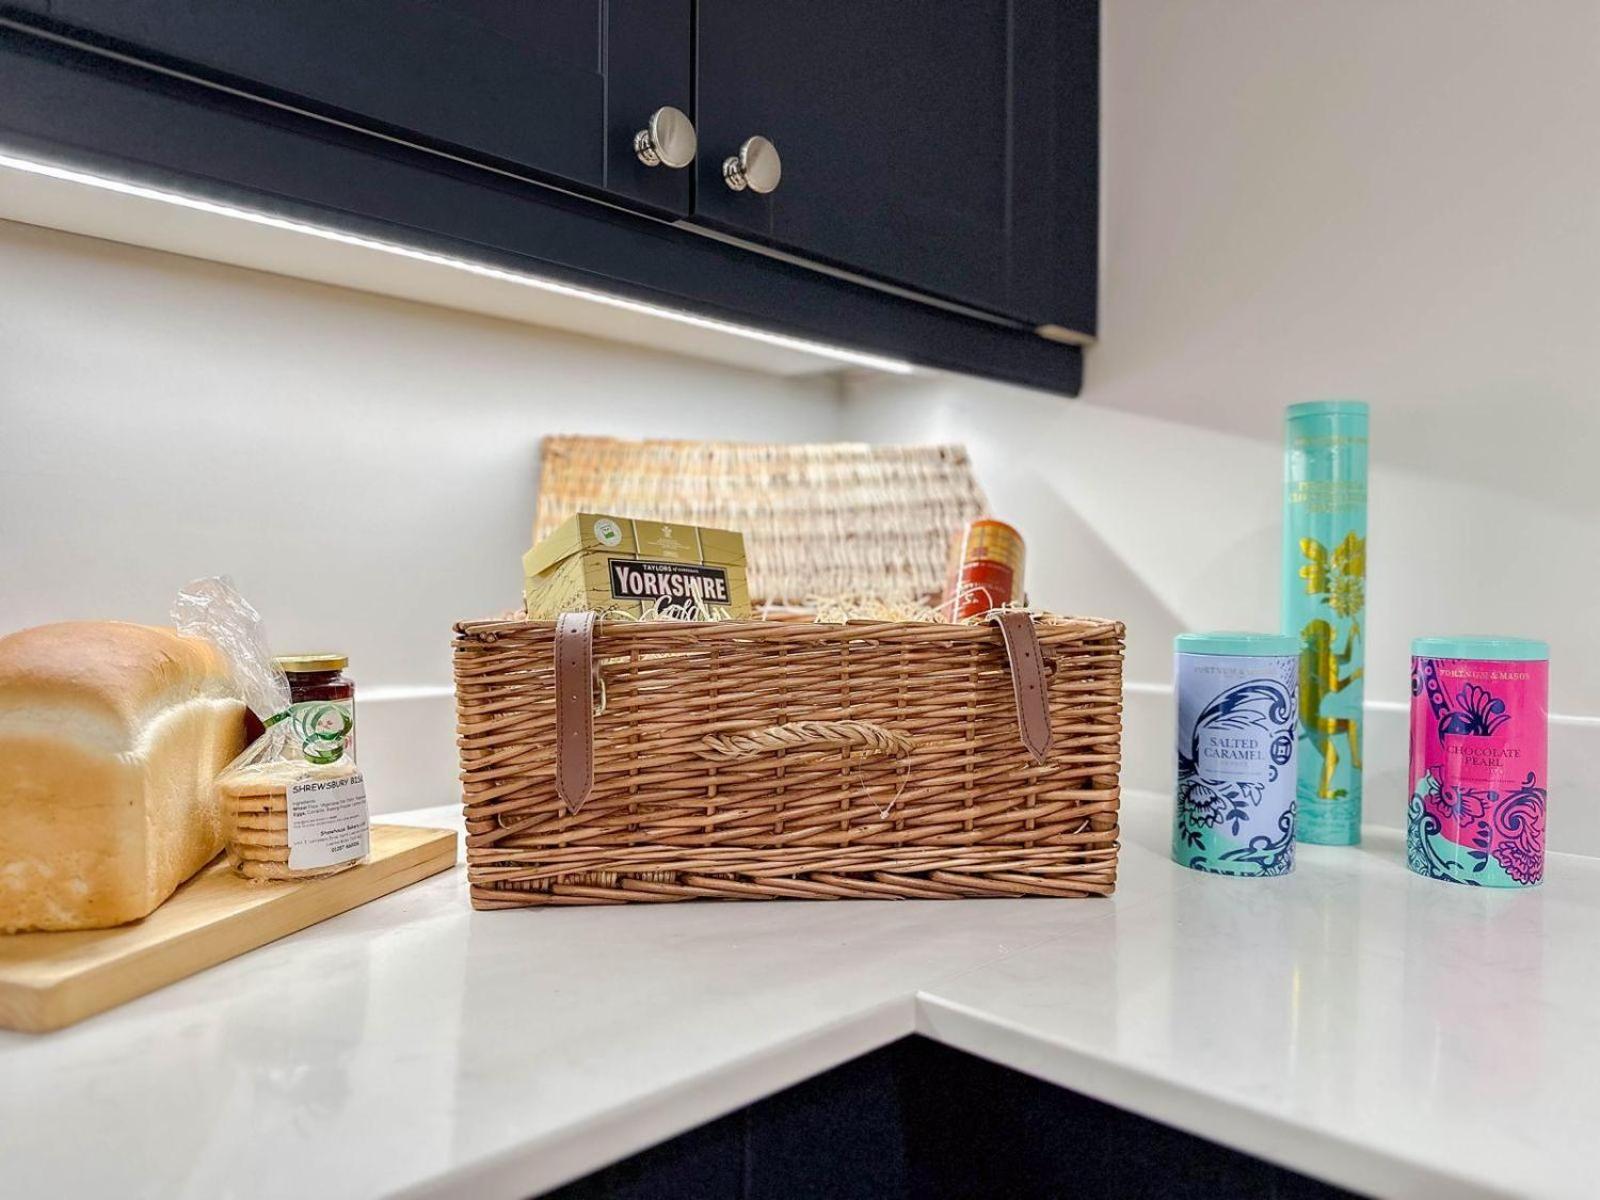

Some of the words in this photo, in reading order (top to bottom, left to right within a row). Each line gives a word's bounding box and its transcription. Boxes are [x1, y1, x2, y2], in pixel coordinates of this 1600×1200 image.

[643, 564, 672, 572] TAYLORS
[615, 566, 727, 600] YORKSHIRE
[1210, 737, 1259, 748] SALTED
[1204, 748, 1265, 761] CARAMEL
[1446, 745, 1520, 758] CHOCOLATE
[1464, 757, 1504, 767] PEARL
[293, 779, 349, 794] SHREWSBURY
